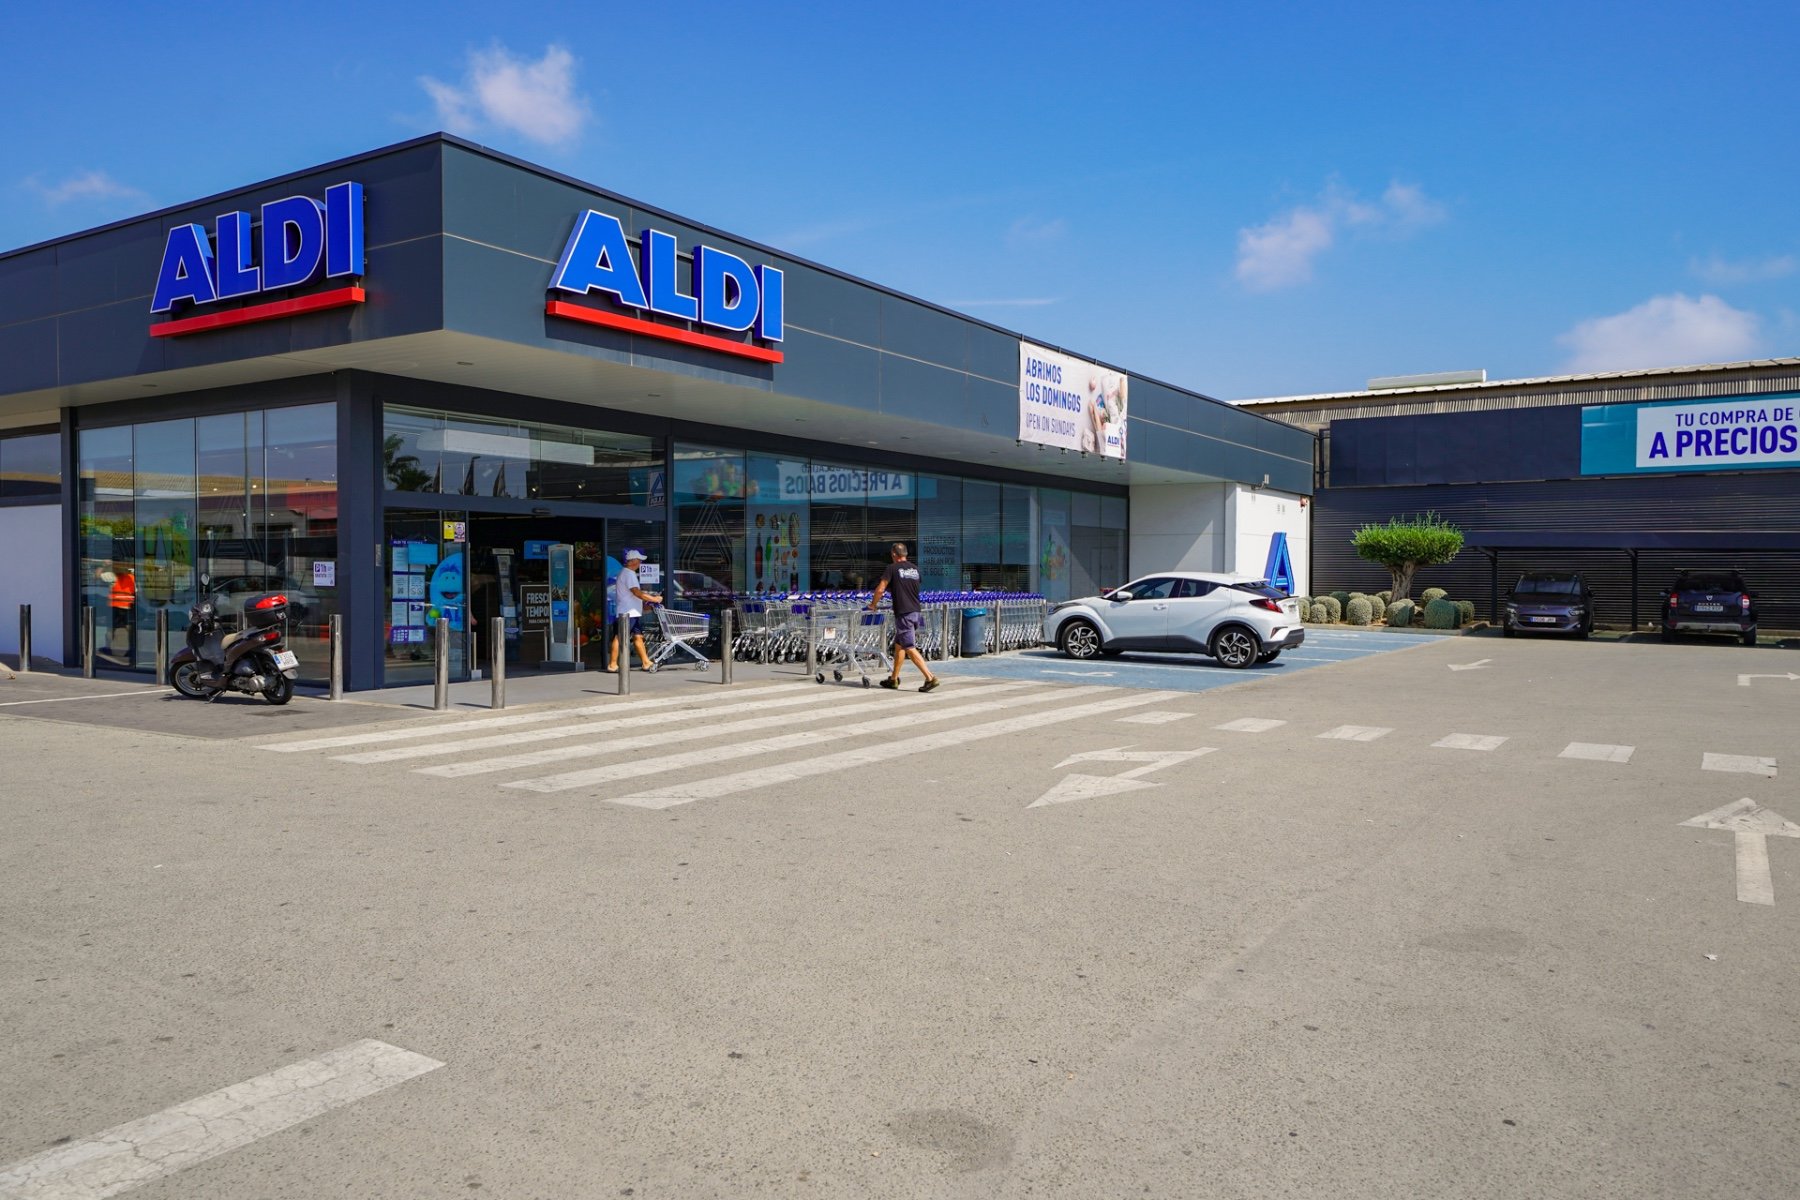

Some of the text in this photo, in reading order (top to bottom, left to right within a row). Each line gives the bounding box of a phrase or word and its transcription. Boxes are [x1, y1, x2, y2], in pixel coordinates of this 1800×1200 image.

[149, 181, 364, 314] ALDI
[547, 209, 784, 342] ALDI
[1025, 357, 1062, 385] ABRIMOS
[1026, 381, 1081, 413] LOS DOMINGOS
[1026, 412, 1075, 437] OPEN ON SUNDAYS
[1675, 413, 1694, 427] TU
[1699, 409, 1768, 425] COMPRA
[1774, 407, 1794, 422] DE
[1648, 424, 1798, 459] A PRECIOS
[525, 606, 549, 618] TEMPO
[526, 592, 549, 604] FRESC
